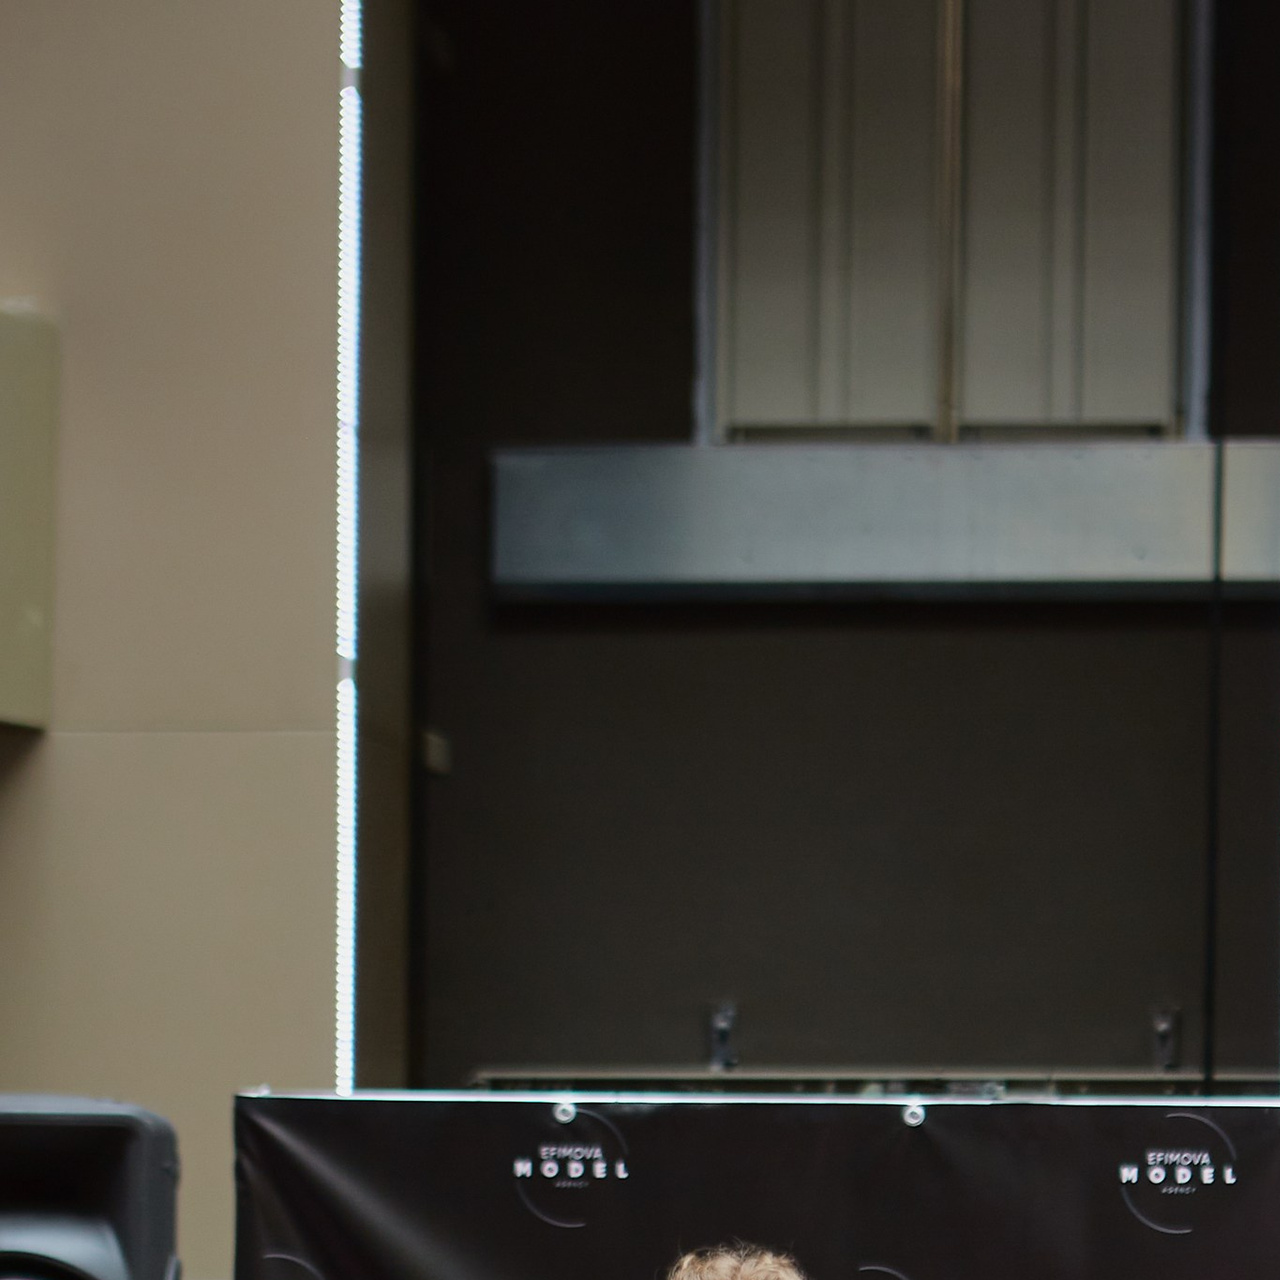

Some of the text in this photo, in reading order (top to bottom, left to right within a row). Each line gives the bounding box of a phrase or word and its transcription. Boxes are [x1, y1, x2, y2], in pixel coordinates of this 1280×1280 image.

[540, 1146, 603, 1160] EFIMOVA
[1147, 1152, 1210, 1166] EFIMOVA
[514, 1160, 629, 1179] MODEL
[1120, 1166, 1237, 1184] MODEL
